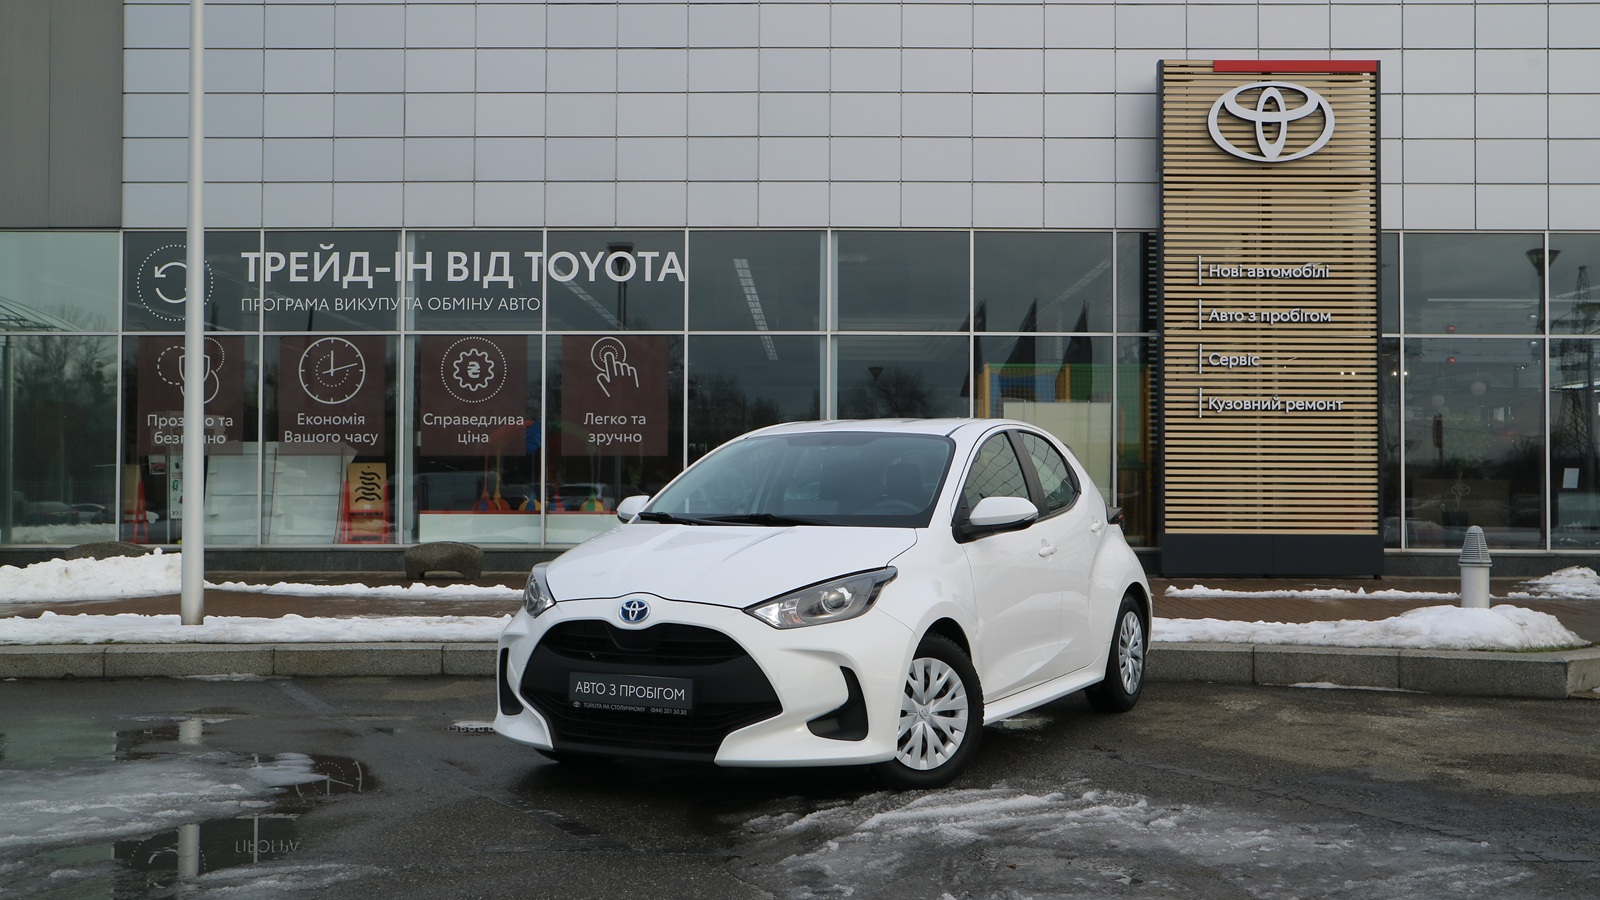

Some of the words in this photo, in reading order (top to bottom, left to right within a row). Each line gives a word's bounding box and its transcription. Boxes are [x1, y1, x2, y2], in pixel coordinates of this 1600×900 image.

[241, 243, 433, 289] ТРЕЙД-ІН
[447, 251, 514, 289] ВІД
[1209, 264, 1243, 278] Нові
[1247, 264, 1330, 278] автомобілі
[241, 297, 330, 312] ПРОГРАМА
[334, 297, 399, 312] ВИКУПУ
[404, 297, 423, 311] ТА
[427, 297, 494, 311] ОБМІНУ
[497, 297, 541, 311] АВТО
[1209, 308, 1244, 322] Авто
[1248, 311, 1256, 322] з
[1260, 308, 1332, 325] пробігом
[1208, 352, 1260, 369] Сервіс
[1208, 396, 1281, 413] Кузовний
[1285, 399, 1344, 413] ремонт
[147, 414, 214, 430] Прозо
[218, 416, 234, 427] та
[297, 412, 365, 426] Економія
[422, 412, 525, 427] Справедлива
[583, 412, 628, 426] Легко
[630, 415, 647, 426] та
[284, 430, 341, 444] Вашого
[344, 432, 378, 447] часу
[457, 431, 489, 446] ціна
[587, 432, 643, 446] зручно
[575, 681, 606, 695] АВТО
[619, 685, 685, 701] ПРОБІГОМ
